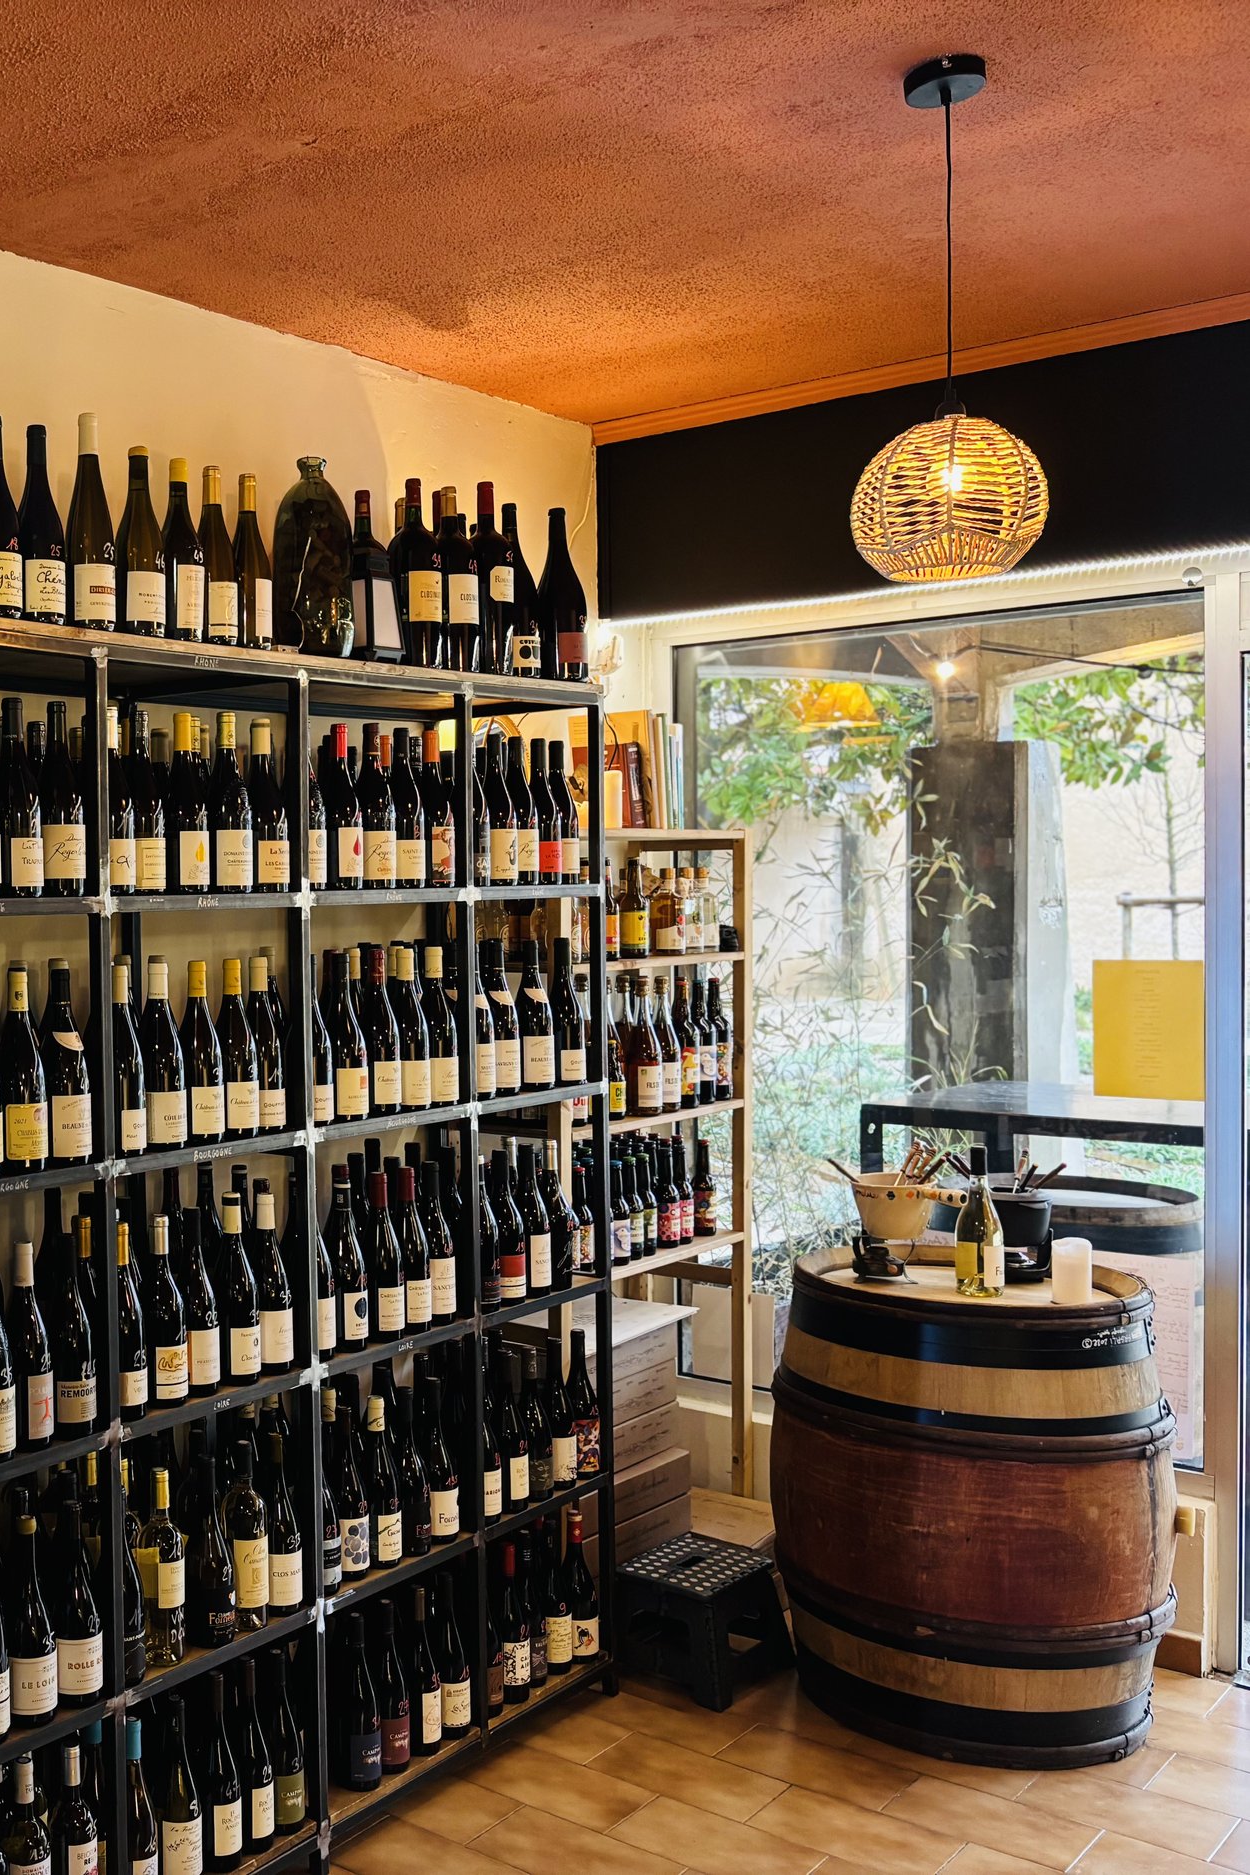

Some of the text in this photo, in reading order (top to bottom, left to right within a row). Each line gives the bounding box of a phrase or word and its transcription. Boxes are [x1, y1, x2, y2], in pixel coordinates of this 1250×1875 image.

[51, 544, 62, 557] 25
[103, 542, 114, 561] 25
[193, 1147, 233, 1161] BOURGOGNE
[214, 1399, 231, 1410] LOIRE
[67, 1660, 95, 1671] ROLLE
